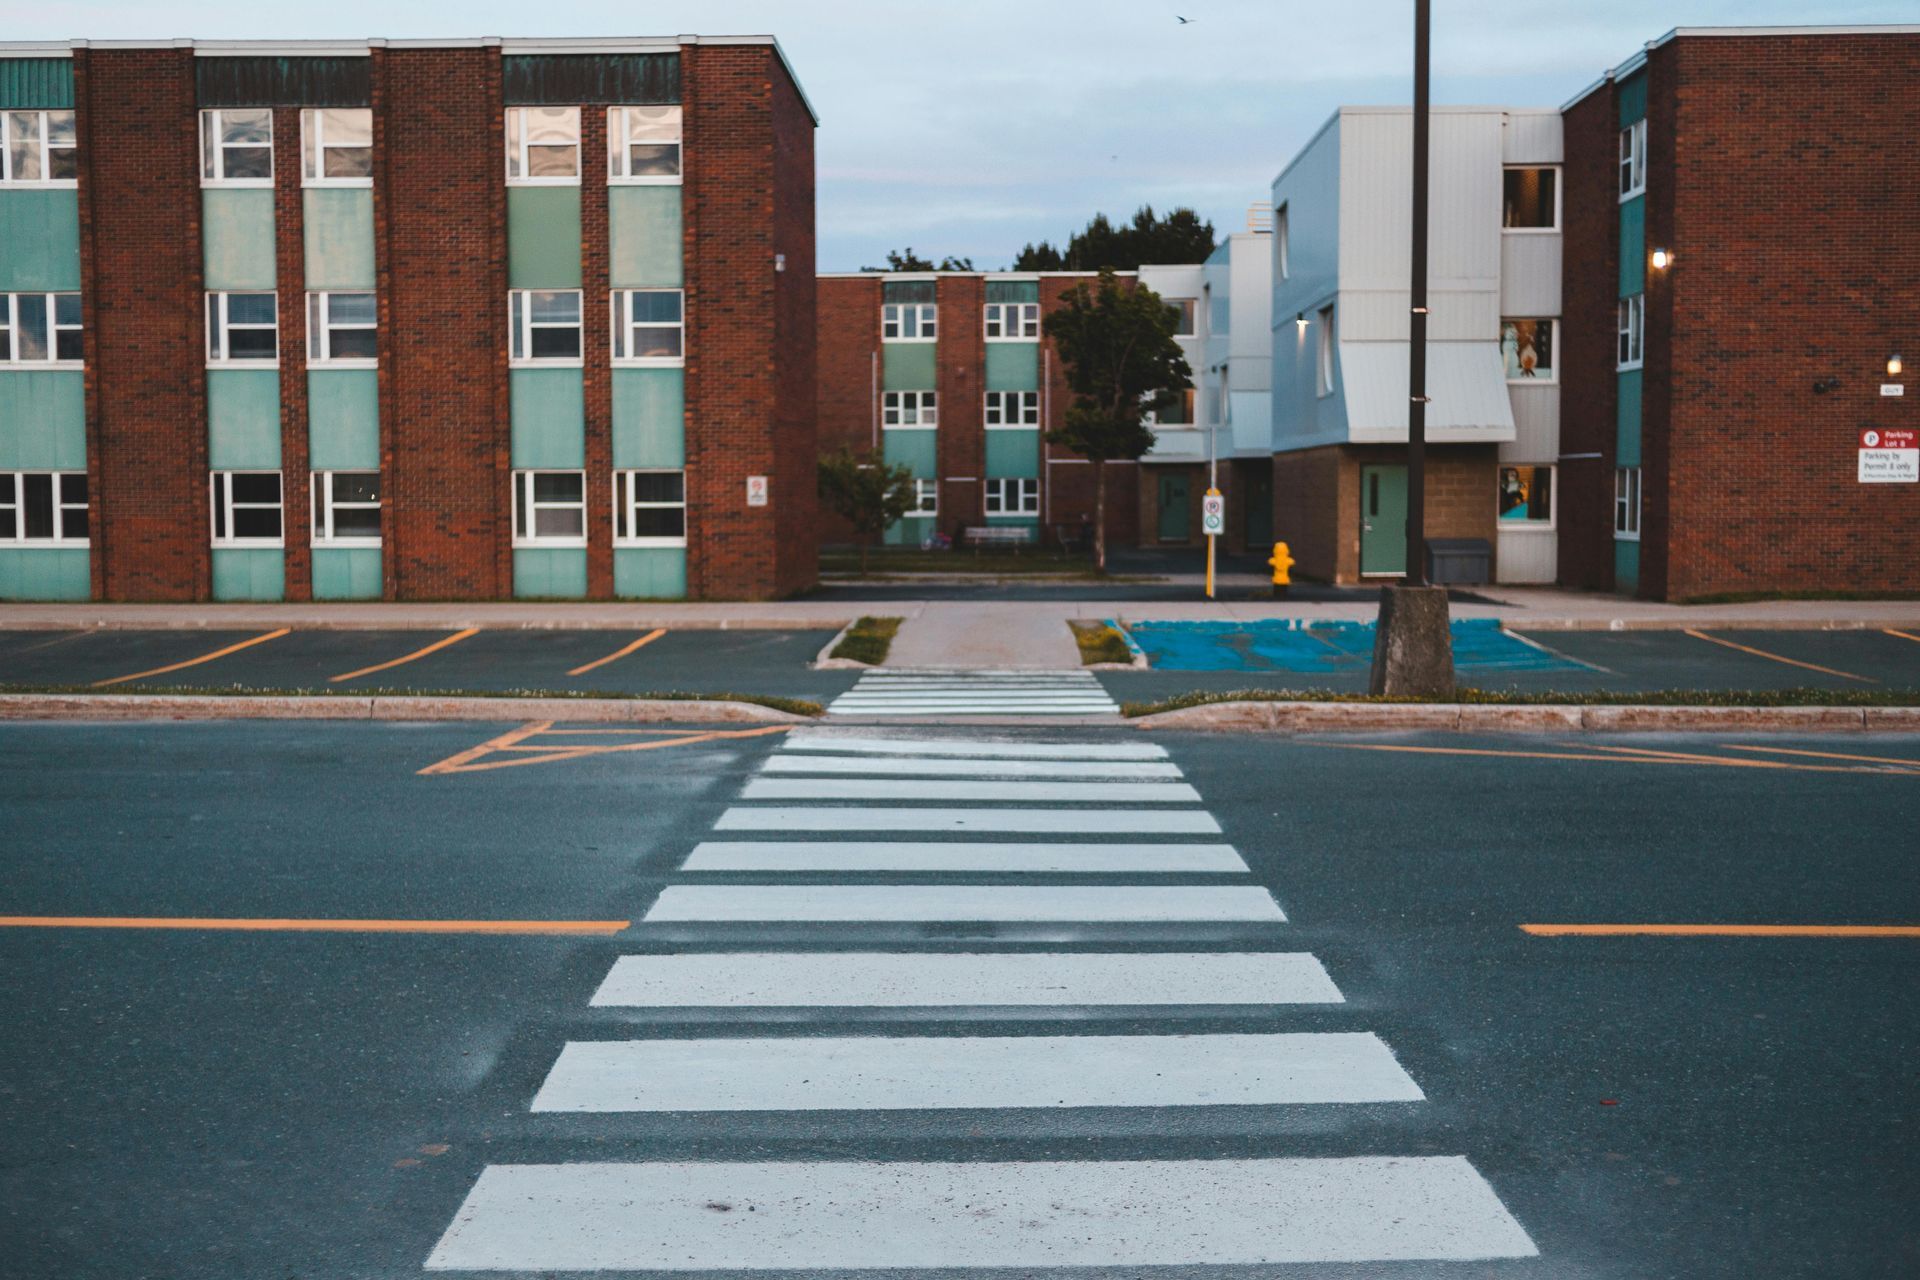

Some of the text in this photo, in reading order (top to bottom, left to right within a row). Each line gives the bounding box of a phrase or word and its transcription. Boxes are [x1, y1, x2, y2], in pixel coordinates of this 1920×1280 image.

[1885, 431, 1913, 440] Parking
[1865, 452, 1900, 461] Parking by
[1896, 463, 1910, 471] only
